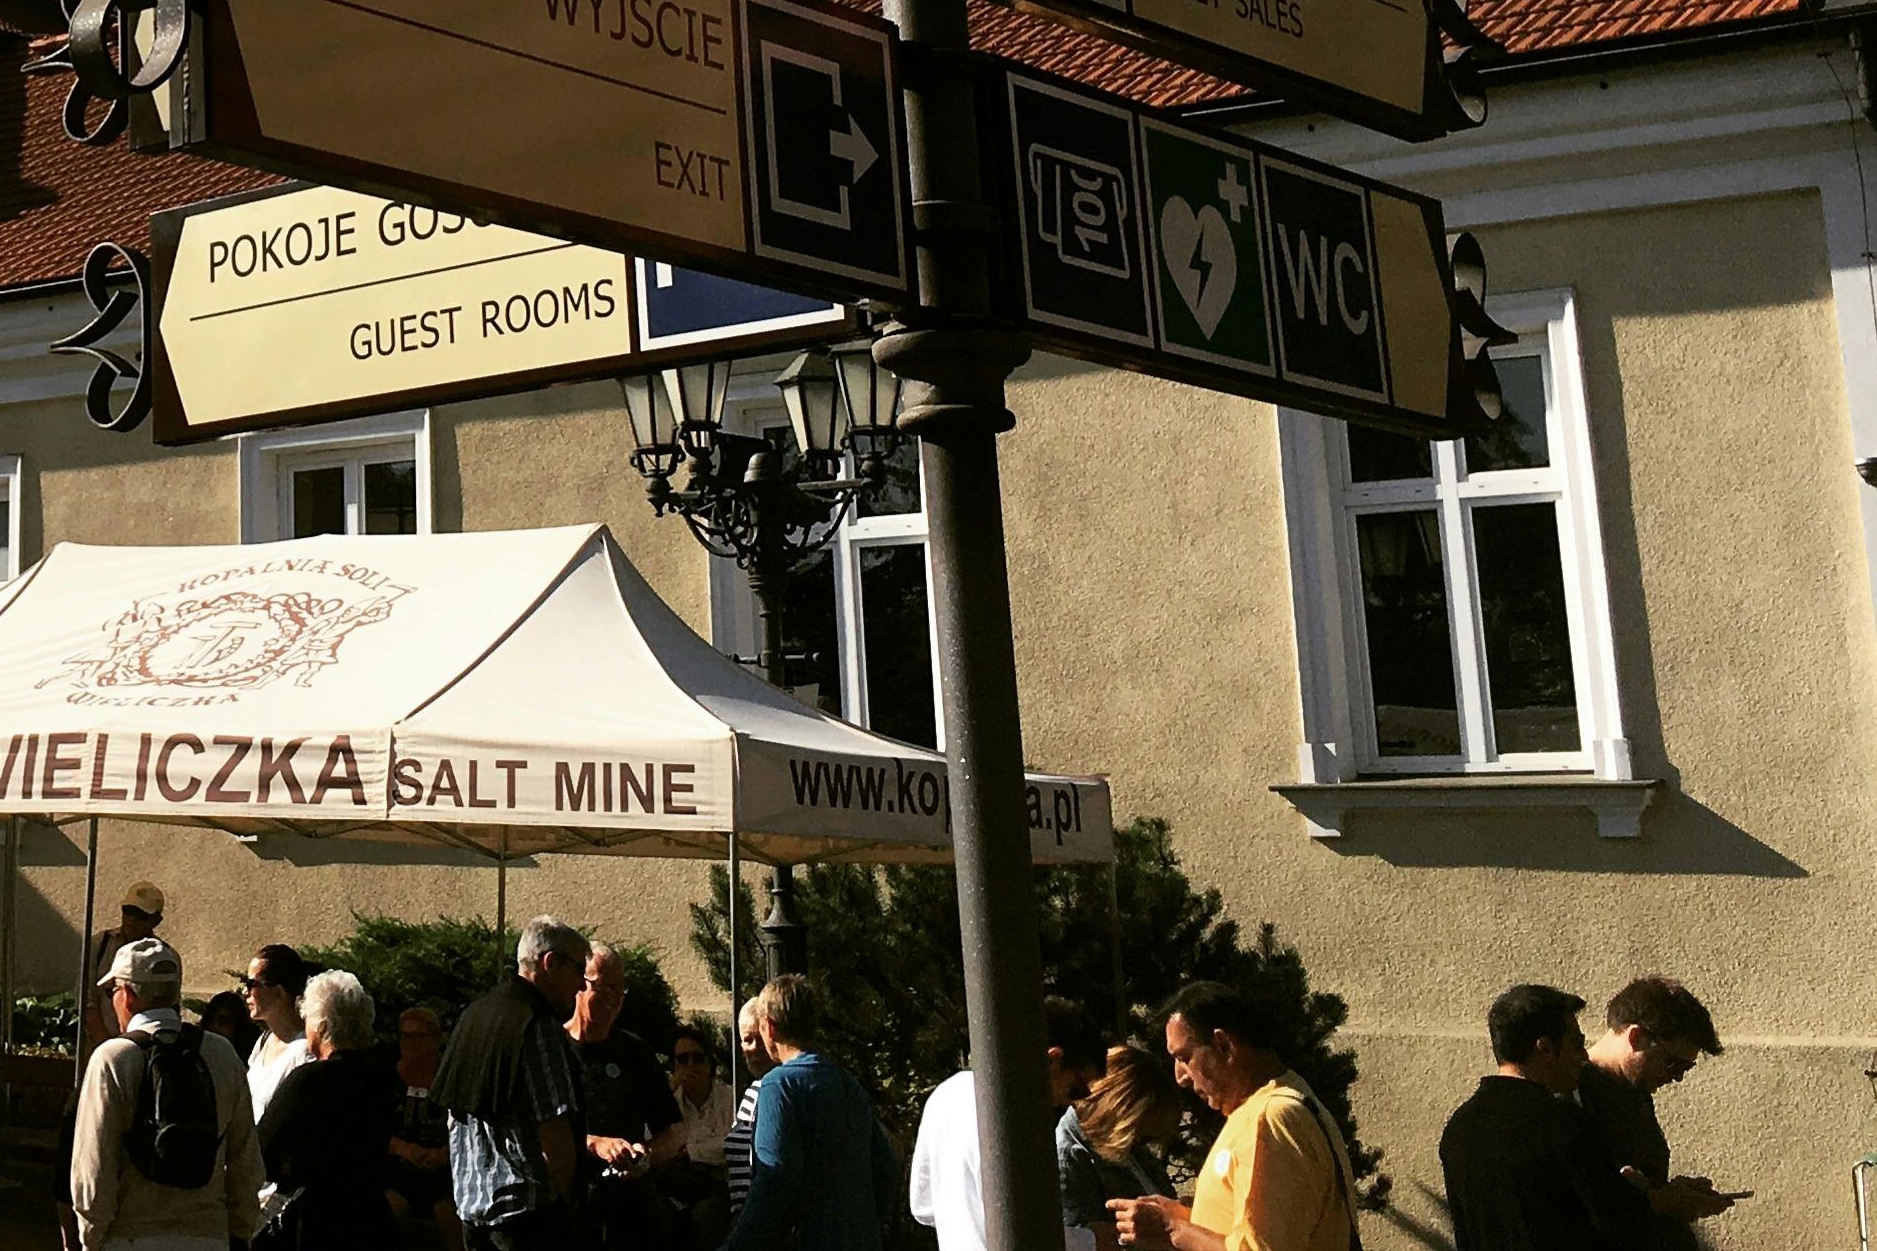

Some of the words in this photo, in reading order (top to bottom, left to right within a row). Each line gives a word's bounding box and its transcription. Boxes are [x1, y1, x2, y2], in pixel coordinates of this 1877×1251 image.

[654, 141, 730, 201] EXIT
[209, 211, 357, 283] POKOJE
[1278, 222, 1369, 335] WC
[350, 306, 462, 360] GUEST
[482, 279, 615, 338] ROOMS
[333, 562, 390, 591] SOLI
[393, 758, 528, 810] SALT
[554, 761, 698, 815] MINE
